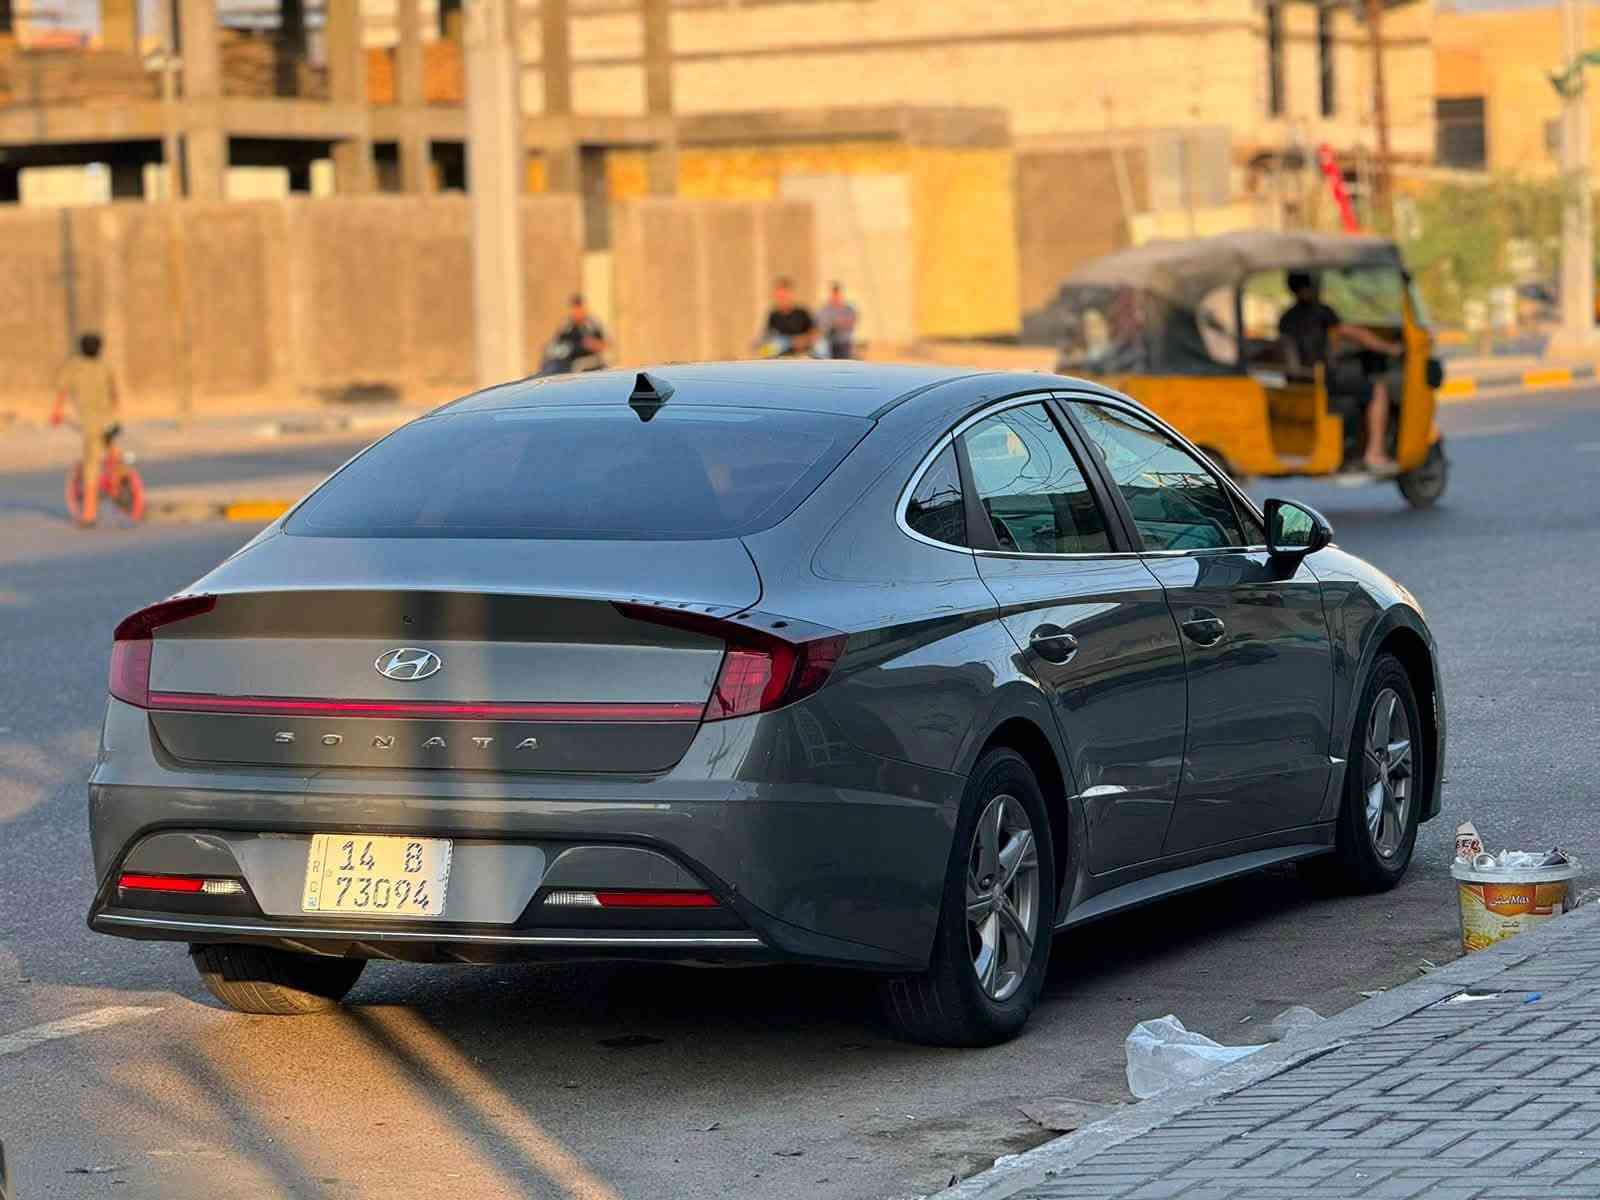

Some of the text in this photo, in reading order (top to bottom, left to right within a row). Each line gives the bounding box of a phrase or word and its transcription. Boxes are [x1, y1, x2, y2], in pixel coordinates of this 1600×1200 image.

[274, 731, 538, 750] SONATA
[339, 840, 376, 871] 14
[335, 876, 430, 910] 73094
